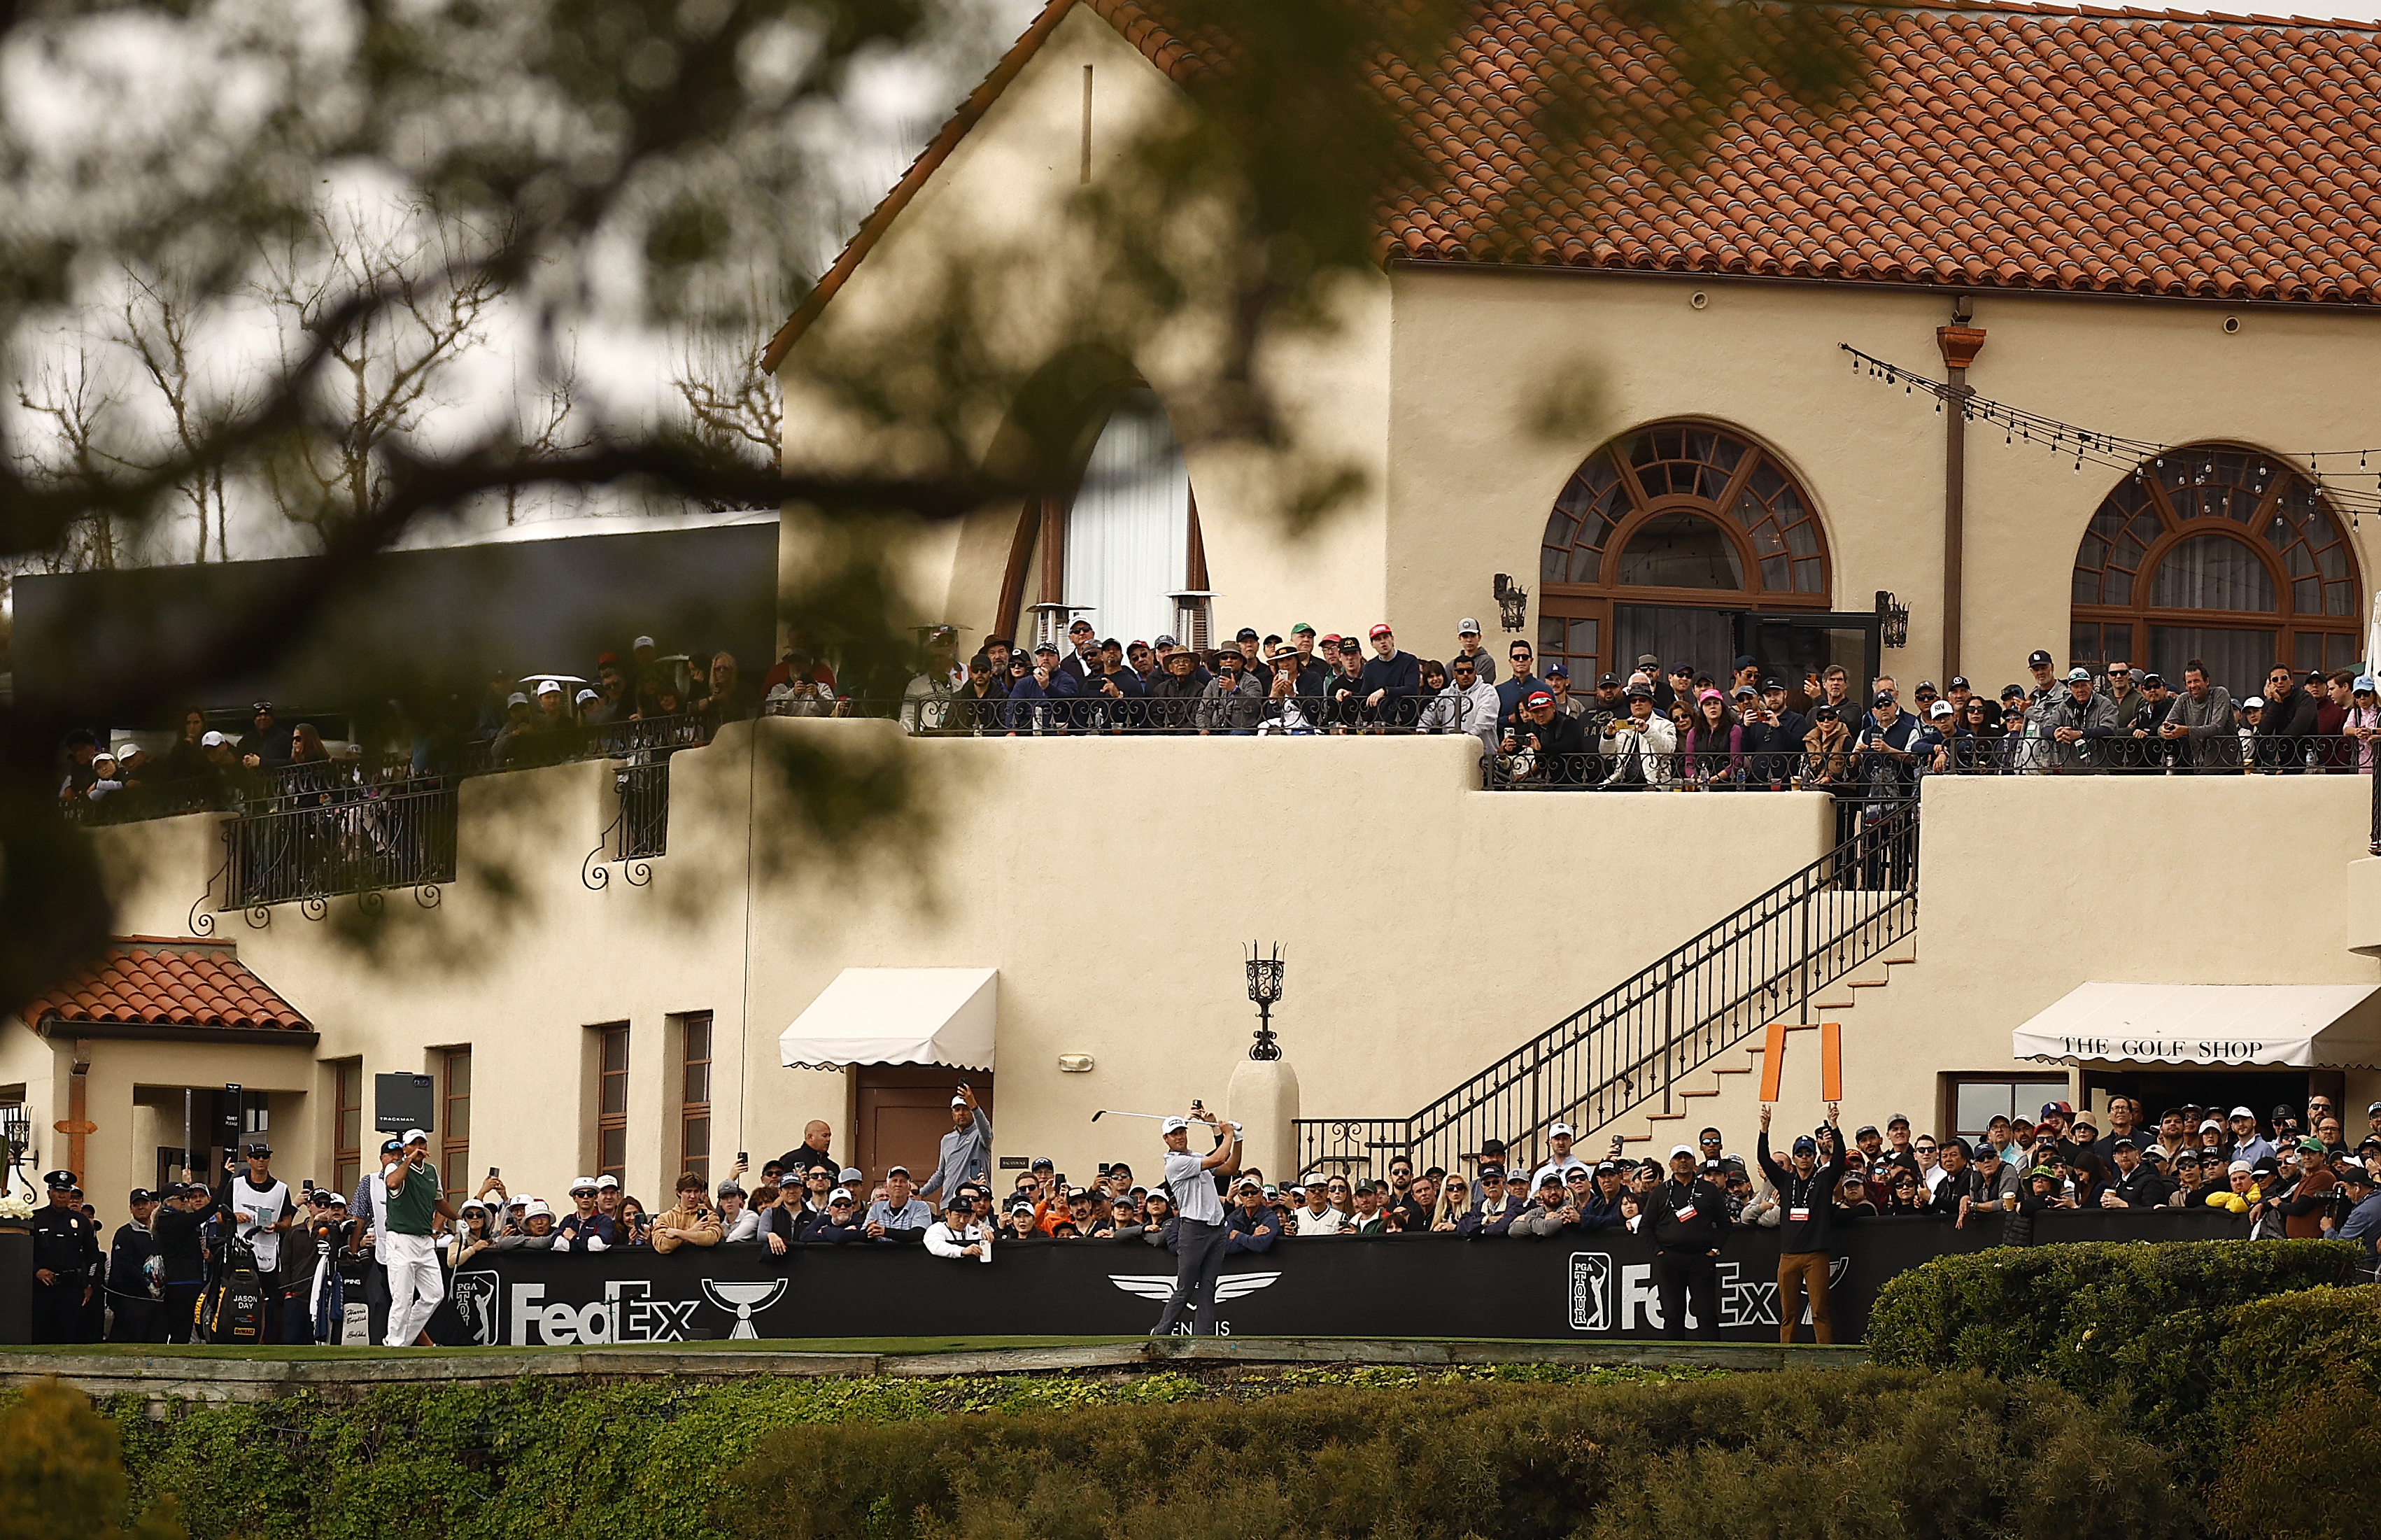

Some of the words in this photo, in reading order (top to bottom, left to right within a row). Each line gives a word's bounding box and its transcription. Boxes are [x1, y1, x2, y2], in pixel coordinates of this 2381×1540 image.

[1935, 703, 1945, 712] RIV
[2061, 1037, 2109, 1054] THE
[2121, 1040, 2186, 1057] GOLF
[2198, 1041, 2263, 1059] SHOP
[1707, 1159, 1719, 1168] RIV
[1574, 1263, 1593, 1271] PGA
[457, 1283, 478, 1291] PGA
[1574, 1271, 1587, 1324] TOUR
[511, 1280, 700, 1345] FedEx
[346, 1315, 367, 1324] English
